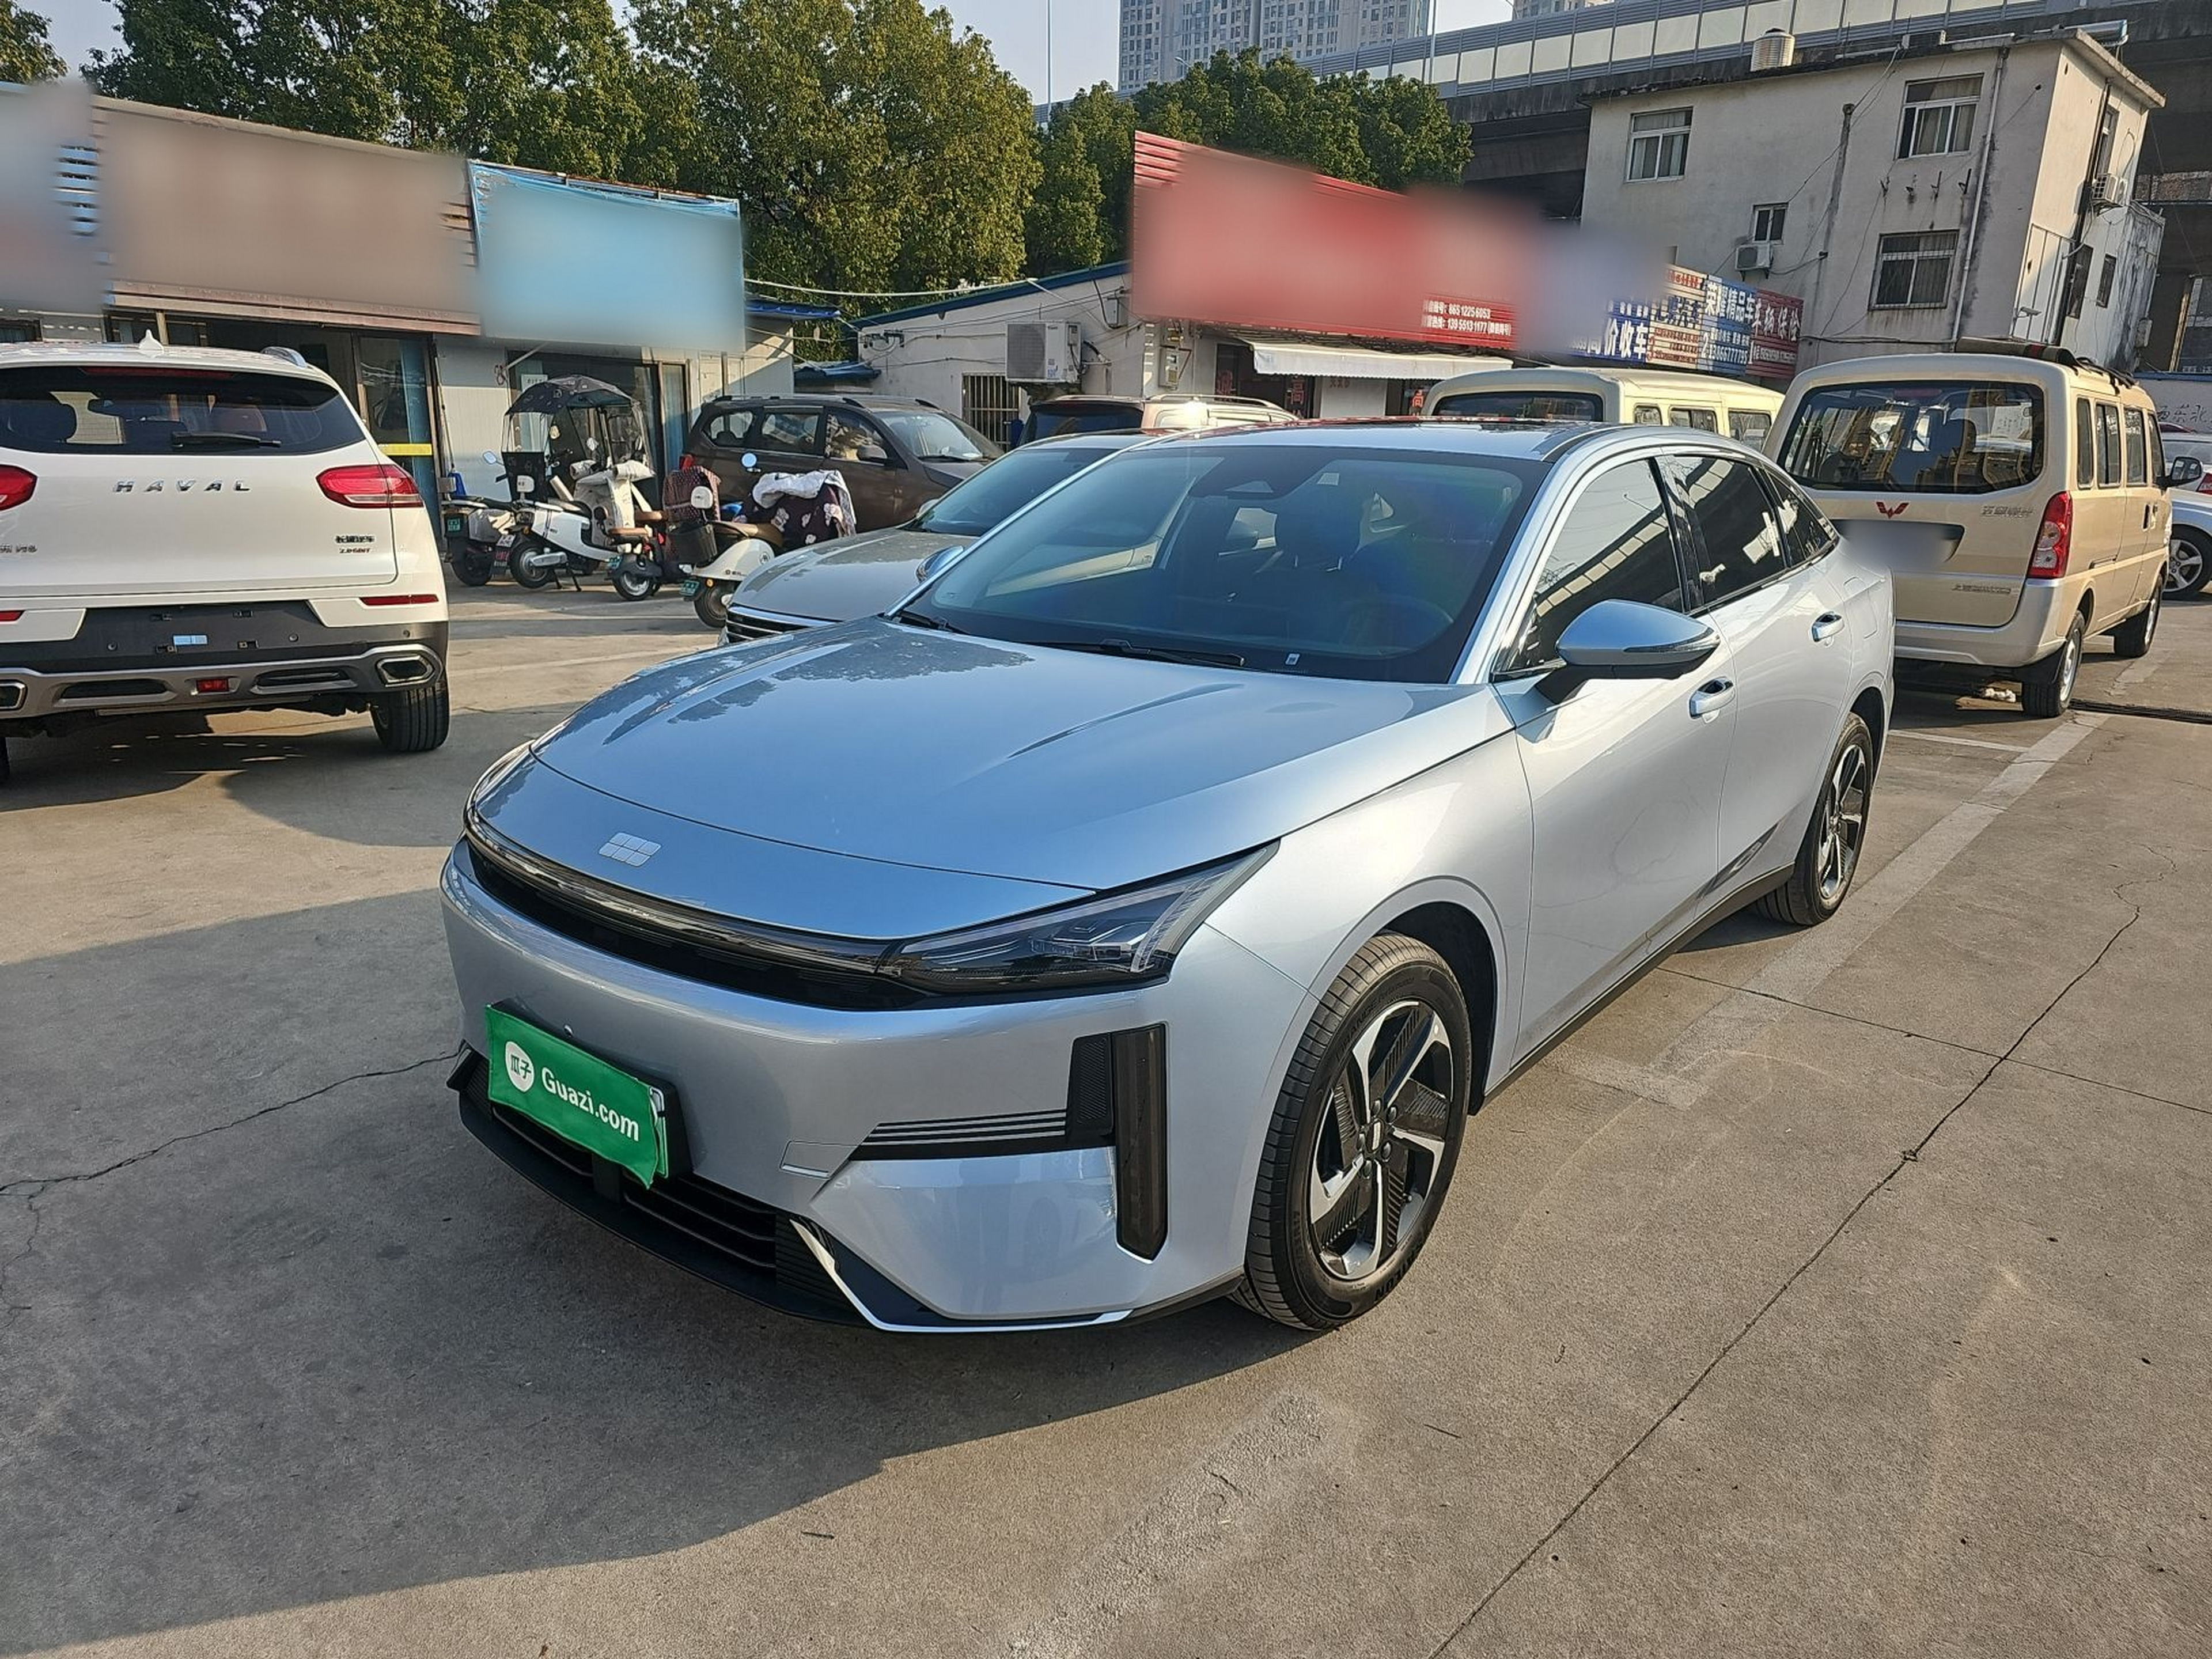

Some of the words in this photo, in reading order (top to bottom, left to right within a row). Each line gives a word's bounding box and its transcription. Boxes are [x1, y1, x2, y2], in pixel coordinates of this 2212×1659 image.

[113, 480, 252, 493] HAVAL
[509, 1053, 532, 1081] 瓜子
[541, 1066, 640, 1142] Guazi.com
